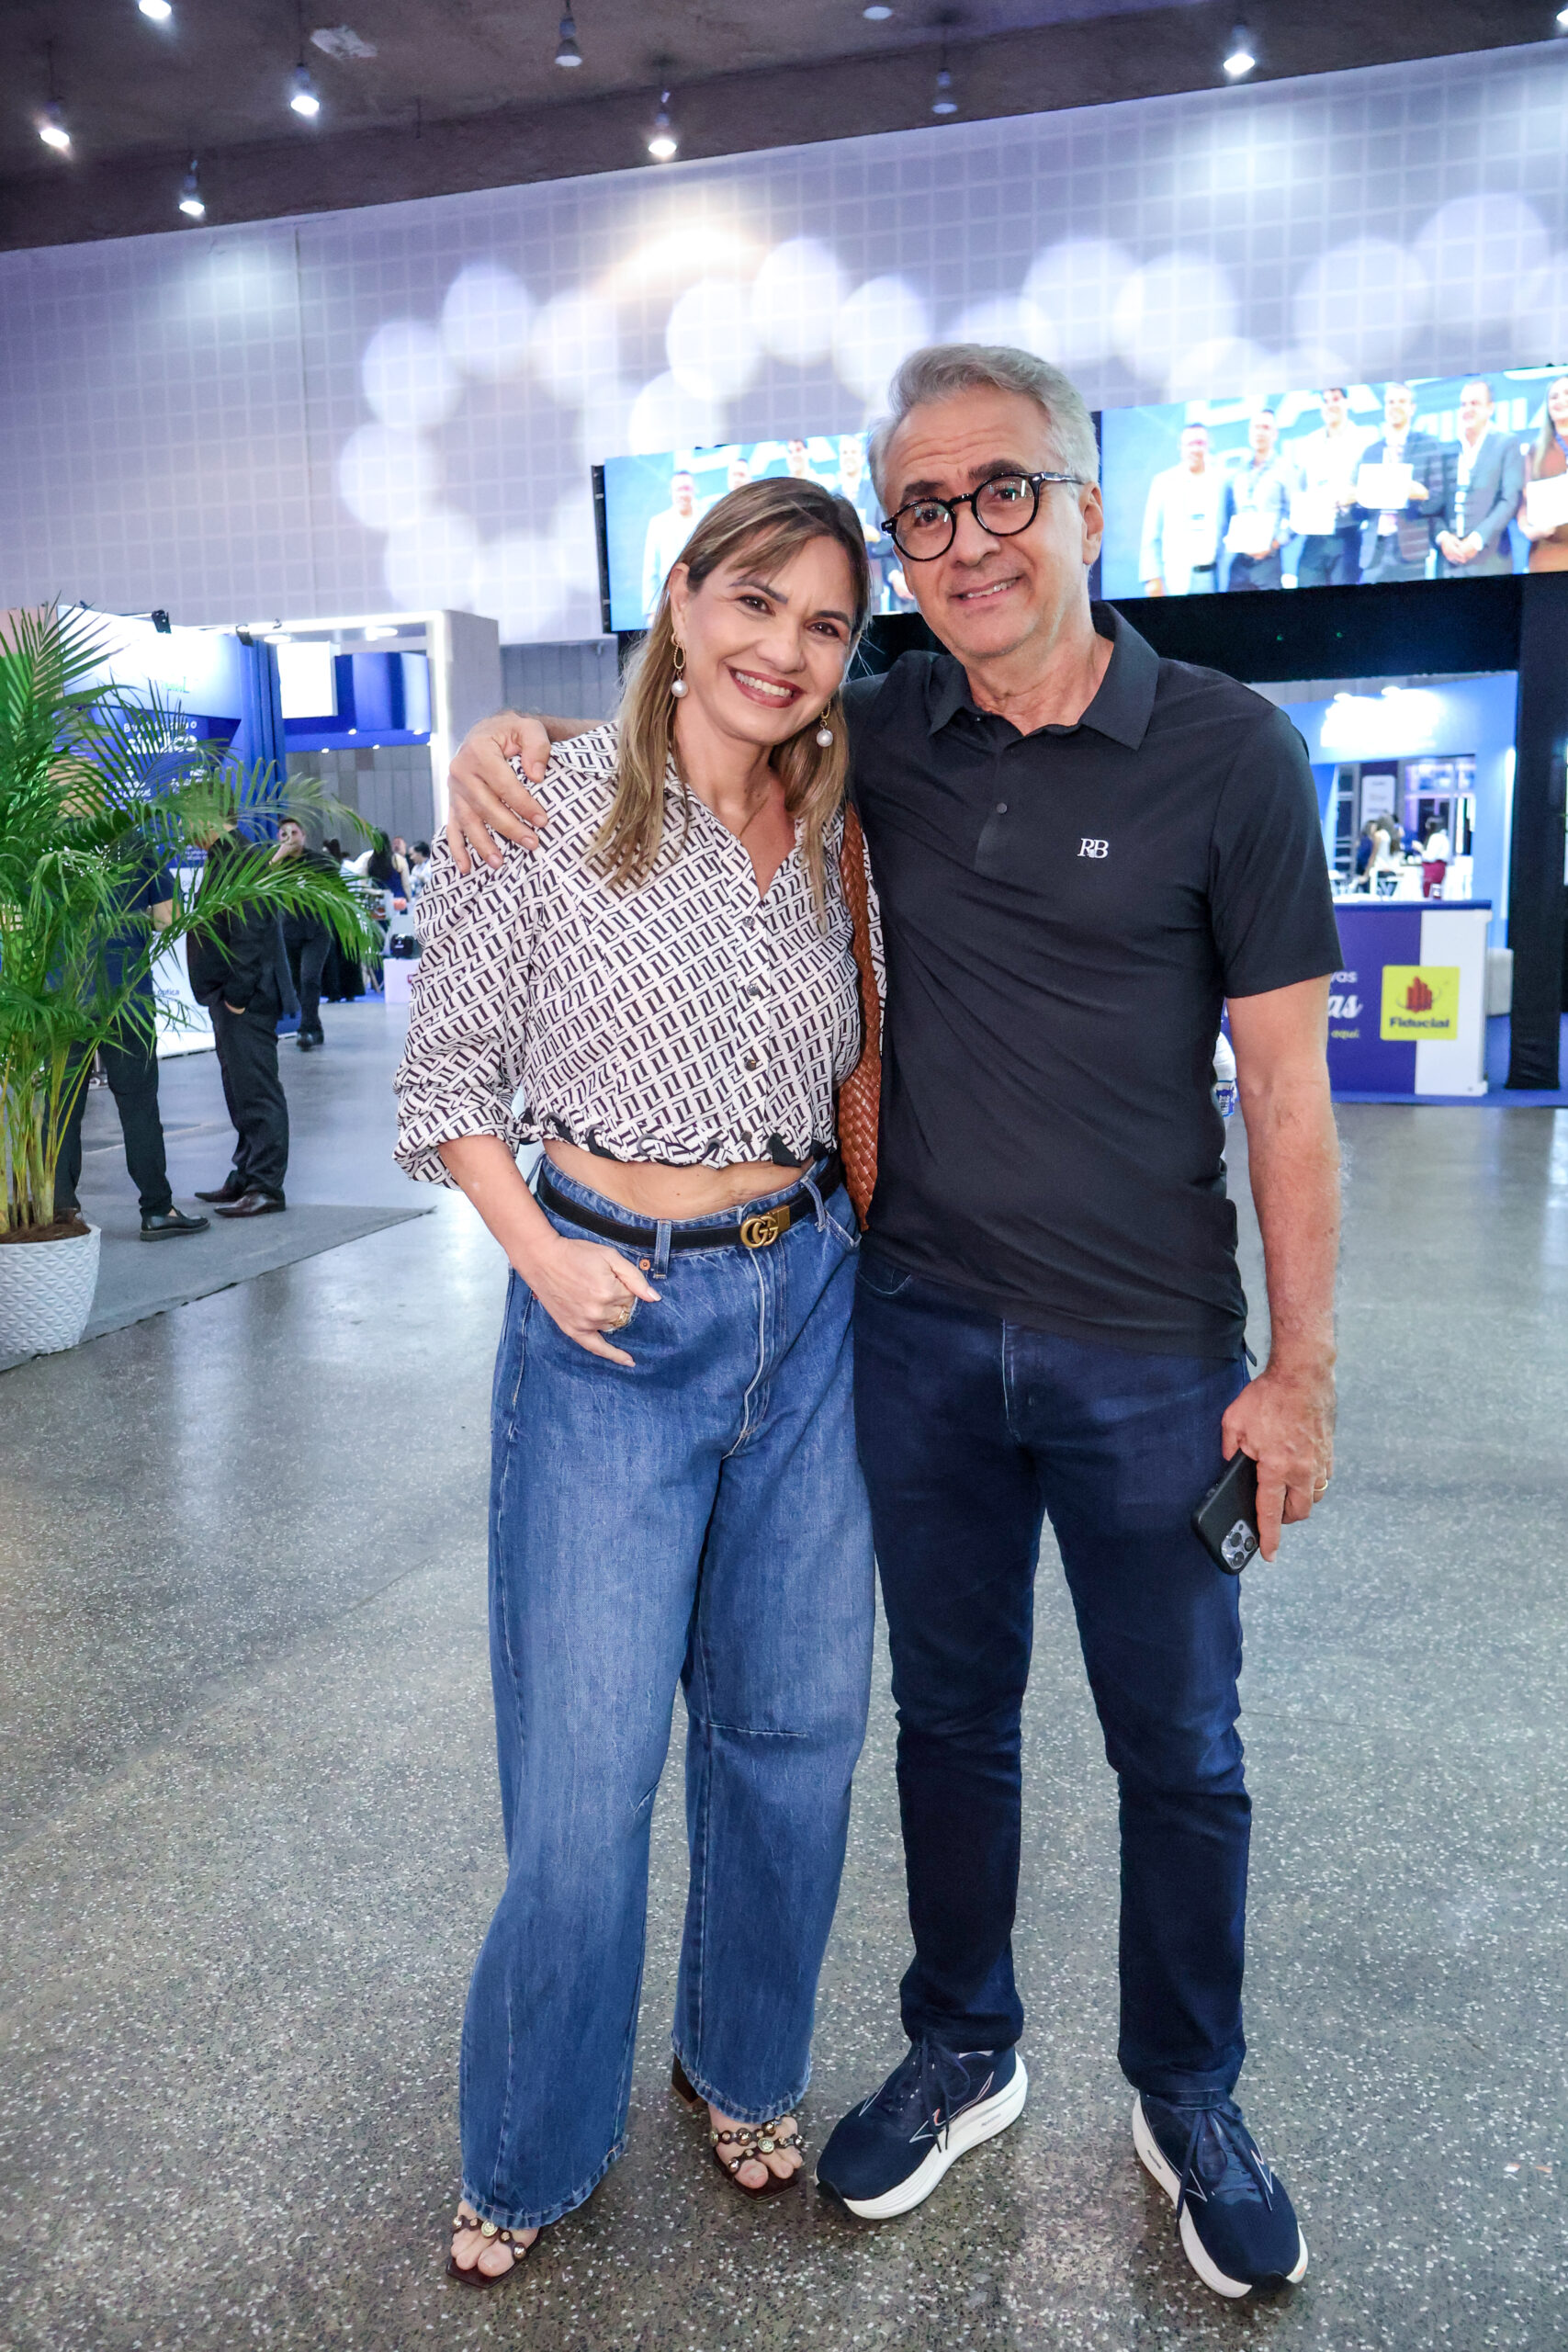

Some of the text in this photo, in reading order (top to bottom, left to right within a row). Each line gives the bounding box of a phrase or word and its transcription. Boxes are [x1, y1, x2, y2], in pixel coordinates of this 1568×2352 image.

[1077, 838, 1109, 858] RB
[1328, 995, 1363, 1019] as
[1390, 1017, 1450, 1028] Fiducial
